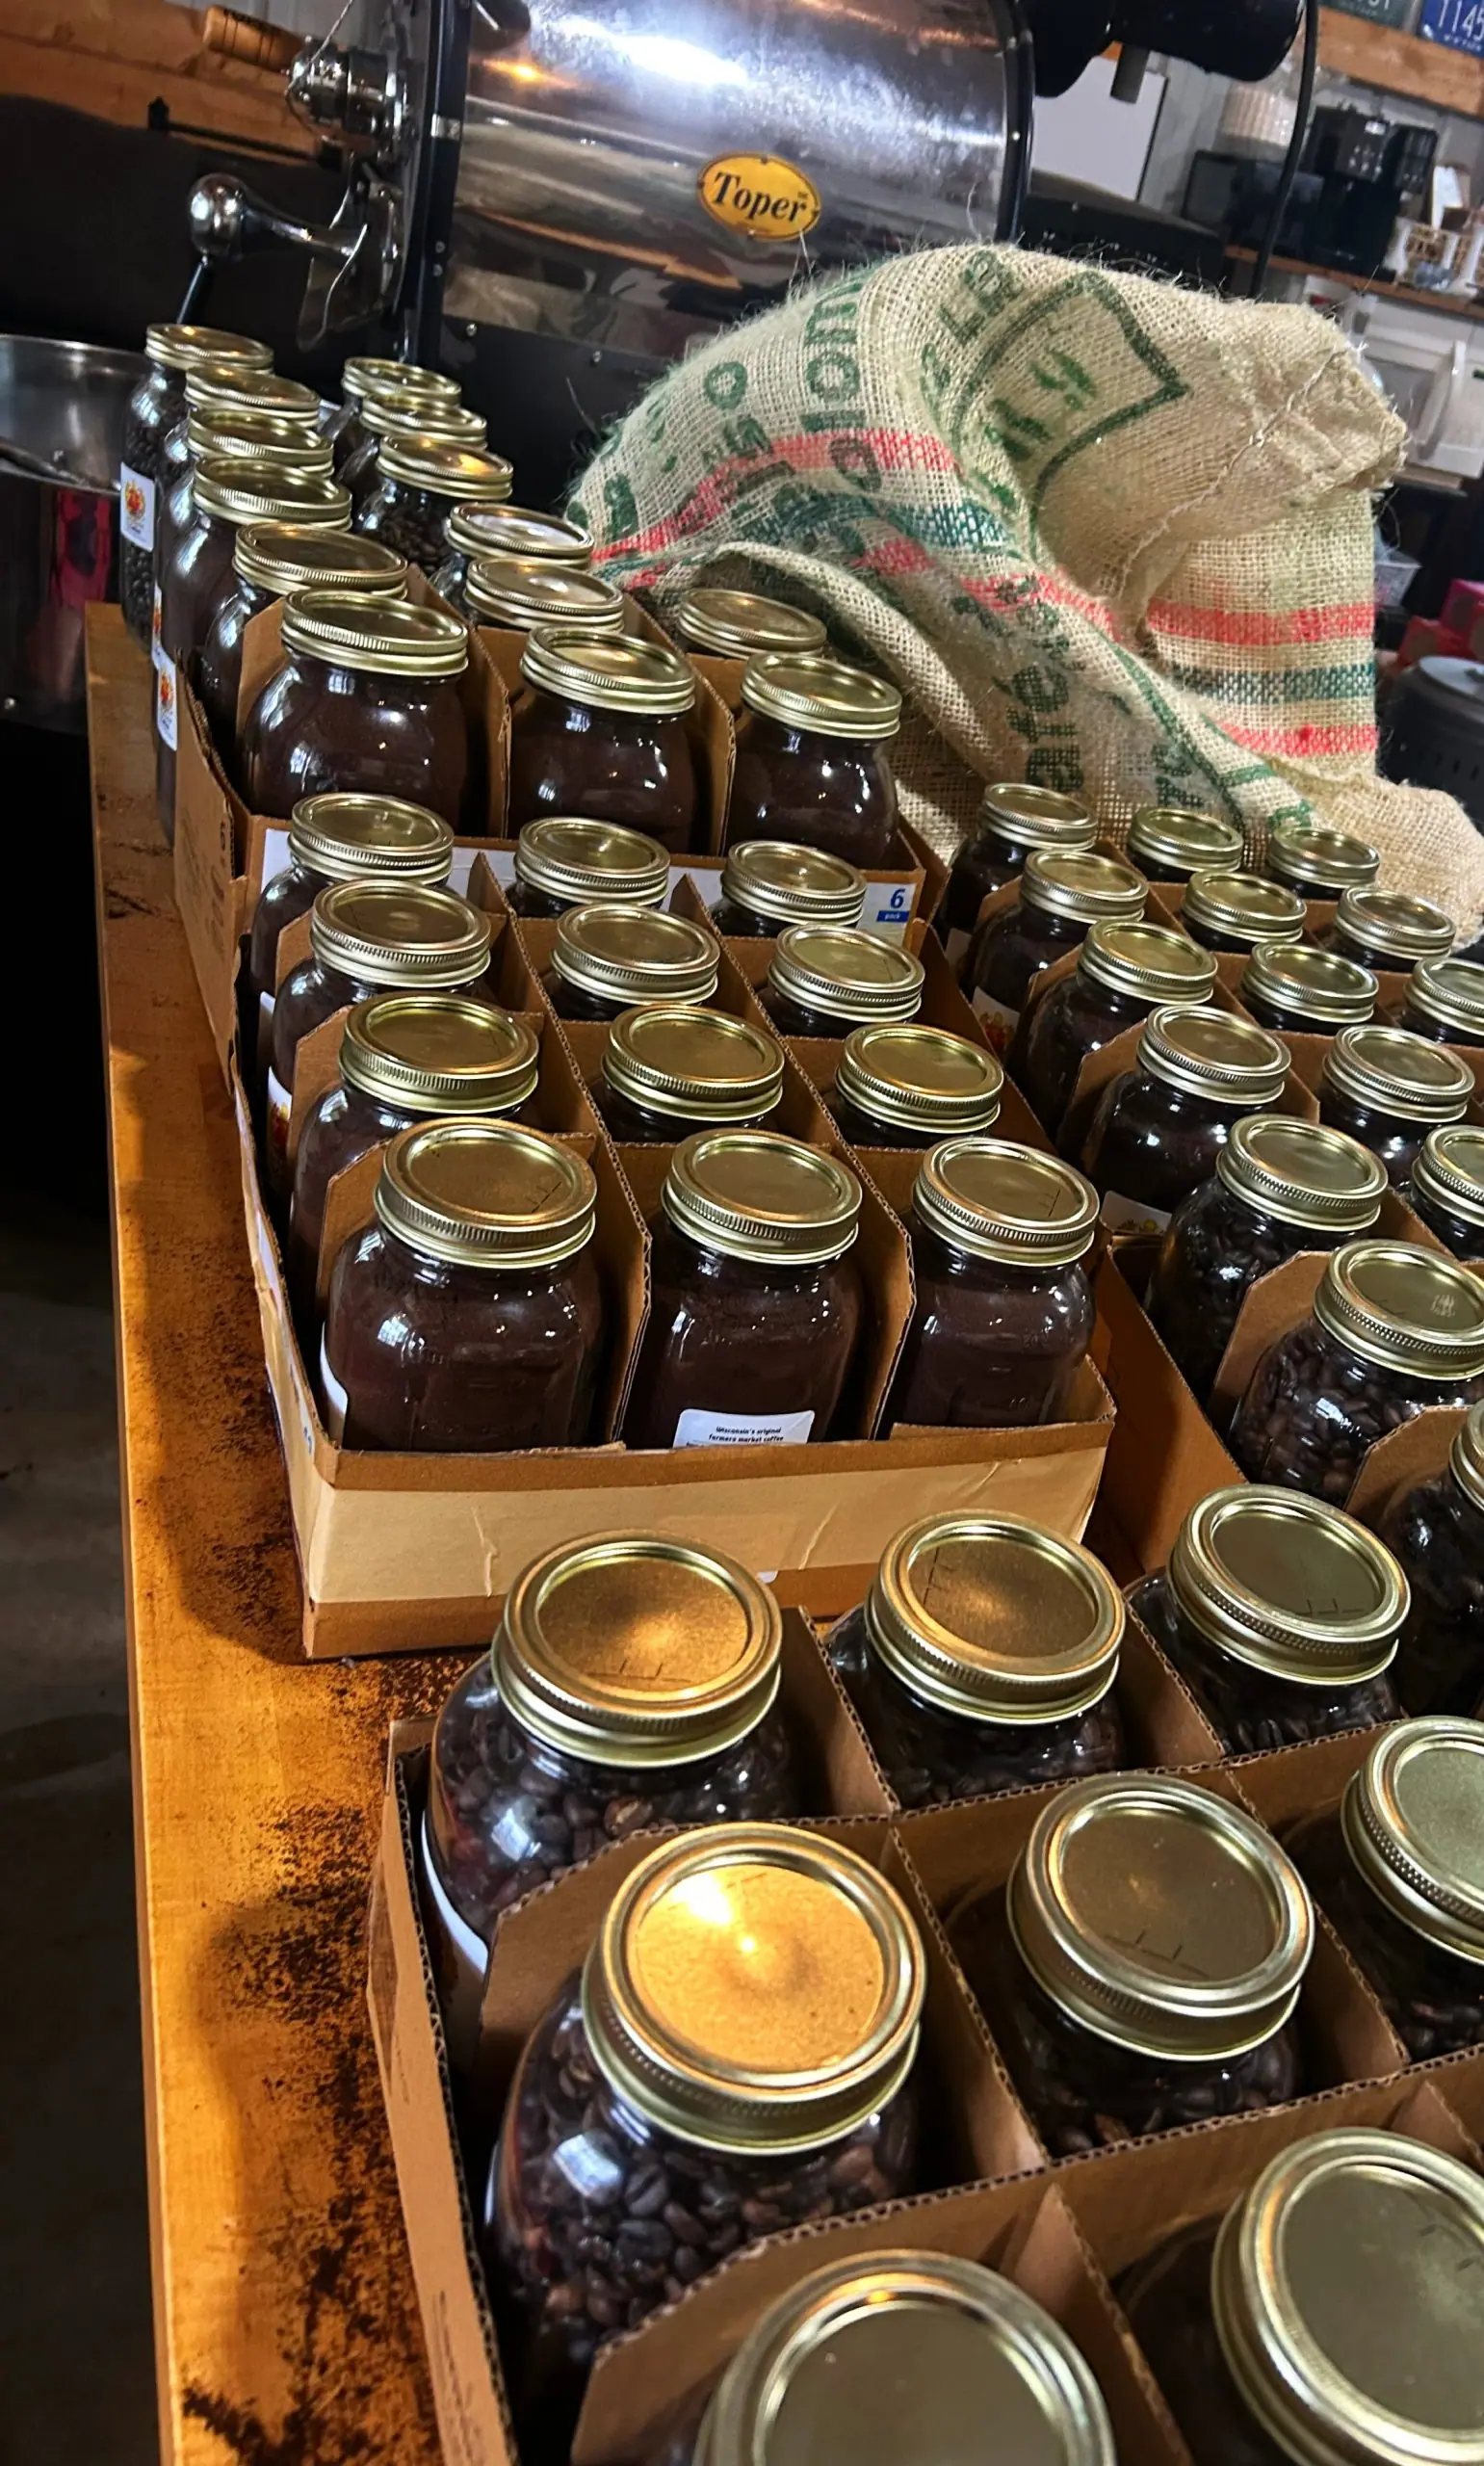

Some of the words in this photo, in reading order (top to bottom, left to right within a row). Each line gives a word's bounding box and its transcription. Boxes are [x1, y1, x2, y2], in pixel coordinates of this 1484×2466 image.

[714, 171, 808, 223] Toper
[890, 888, 906, 909] 6
[708, 1433, 737, 1442] farmers
[716, 1426, 755, 1434] Wisconsin's
[757, 1427, 782, 1435] original
